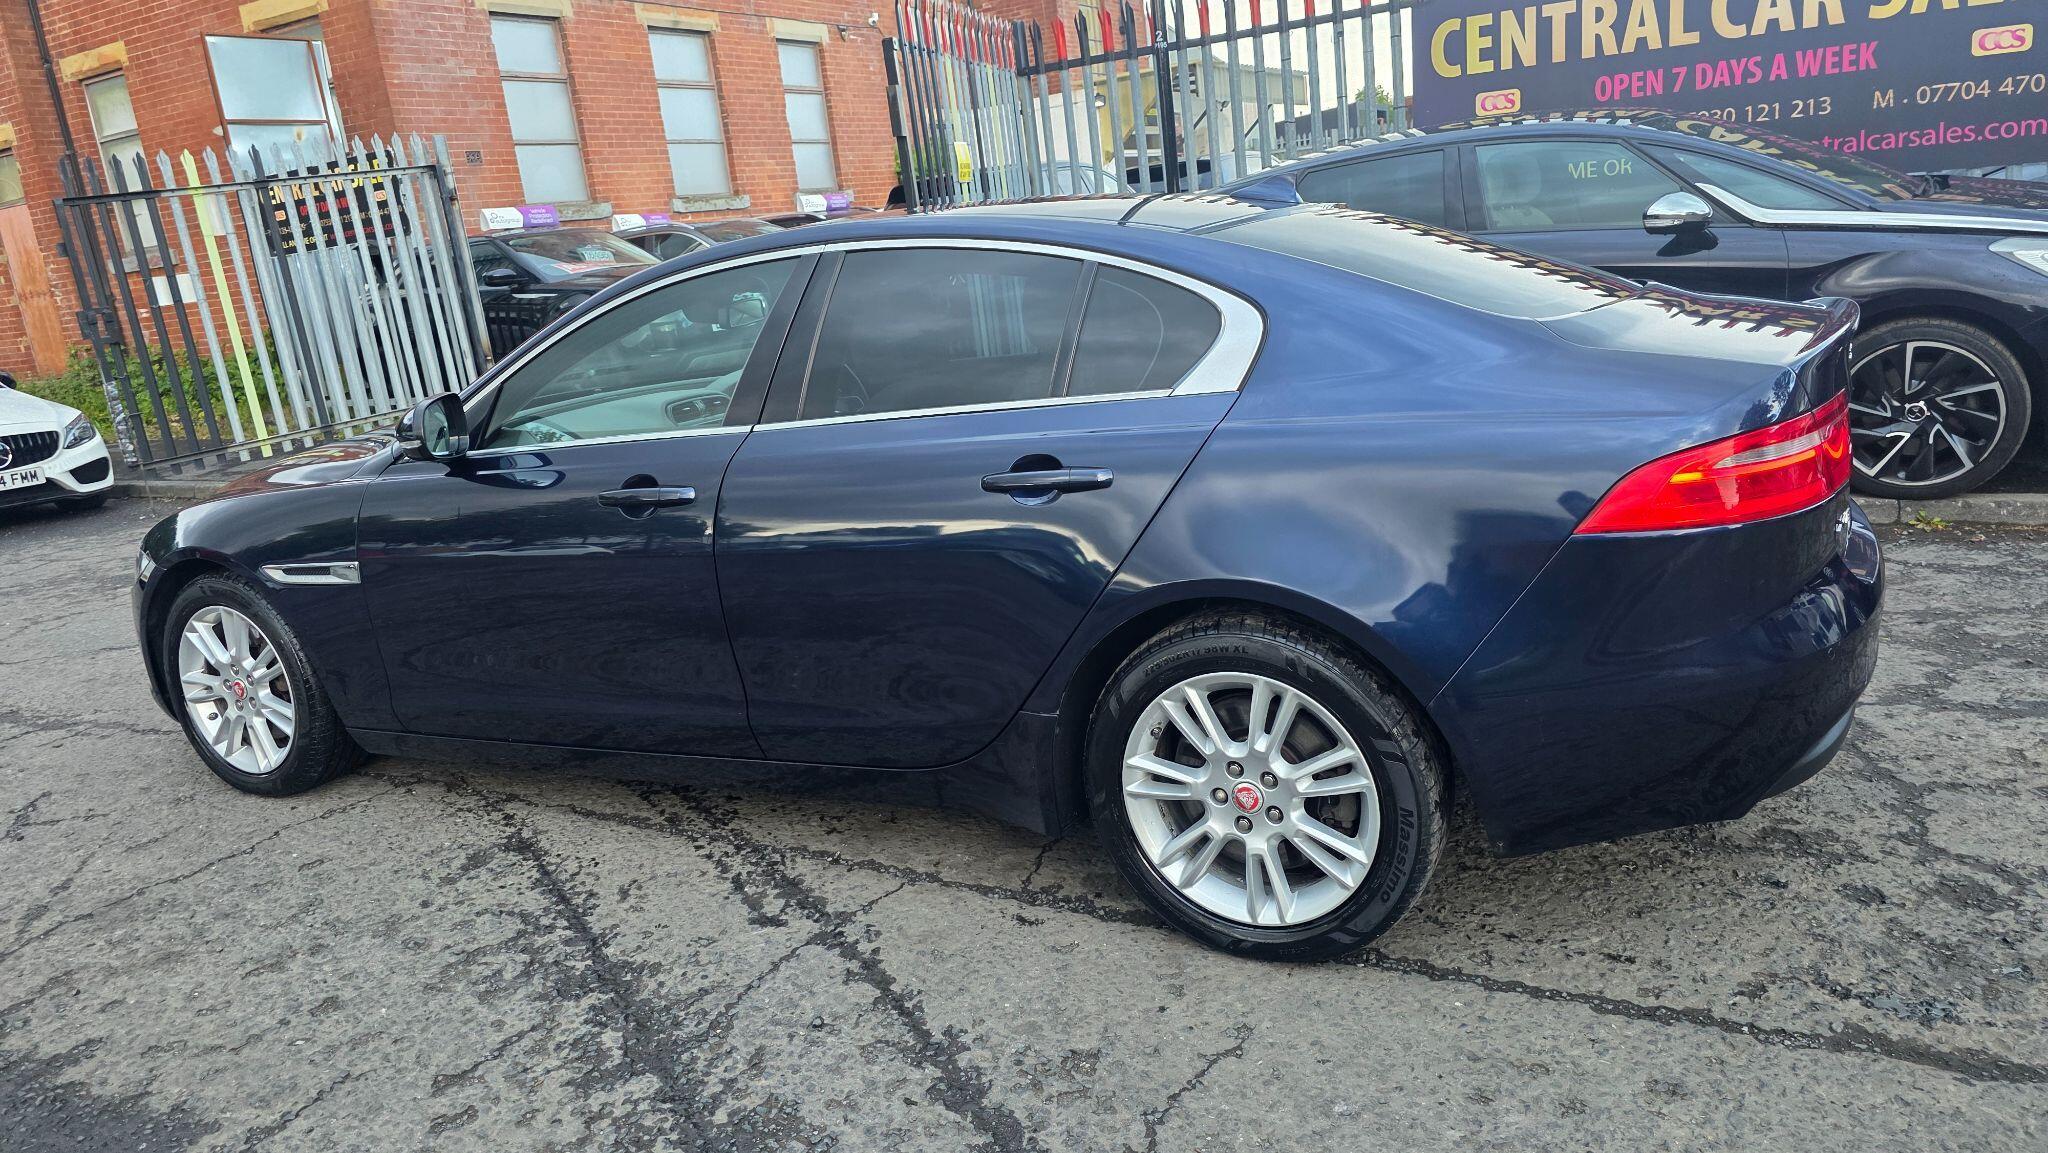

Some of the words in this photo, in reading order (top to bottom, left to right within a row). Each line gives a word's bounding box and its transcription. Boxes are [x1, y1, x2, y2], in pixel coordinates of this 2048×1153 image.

[1430, 0, 1700, 78] CENTRAL
[1594, 69, 1664, 102] OPEN
[1672, 66, 1688, 93] 7
[1695, 56, 1763, 91] DAYS
[1769, 53, 1788, 82] A
[1796, 41, 1880, 78] WEEK
[1744, 102, 1781, 123] 121
[1790, 96, 1832, 119] 213
[1872, 88, 1895, 110] M
[1916, 79, 1992, 105] 07704
[1998, 73, 2047, 96] 470
[1811, 118, 2048, 154] tralcarsales.com
[11, 470, 39, 486] FMM
[1381, 806, 1415, 904] Massimo
